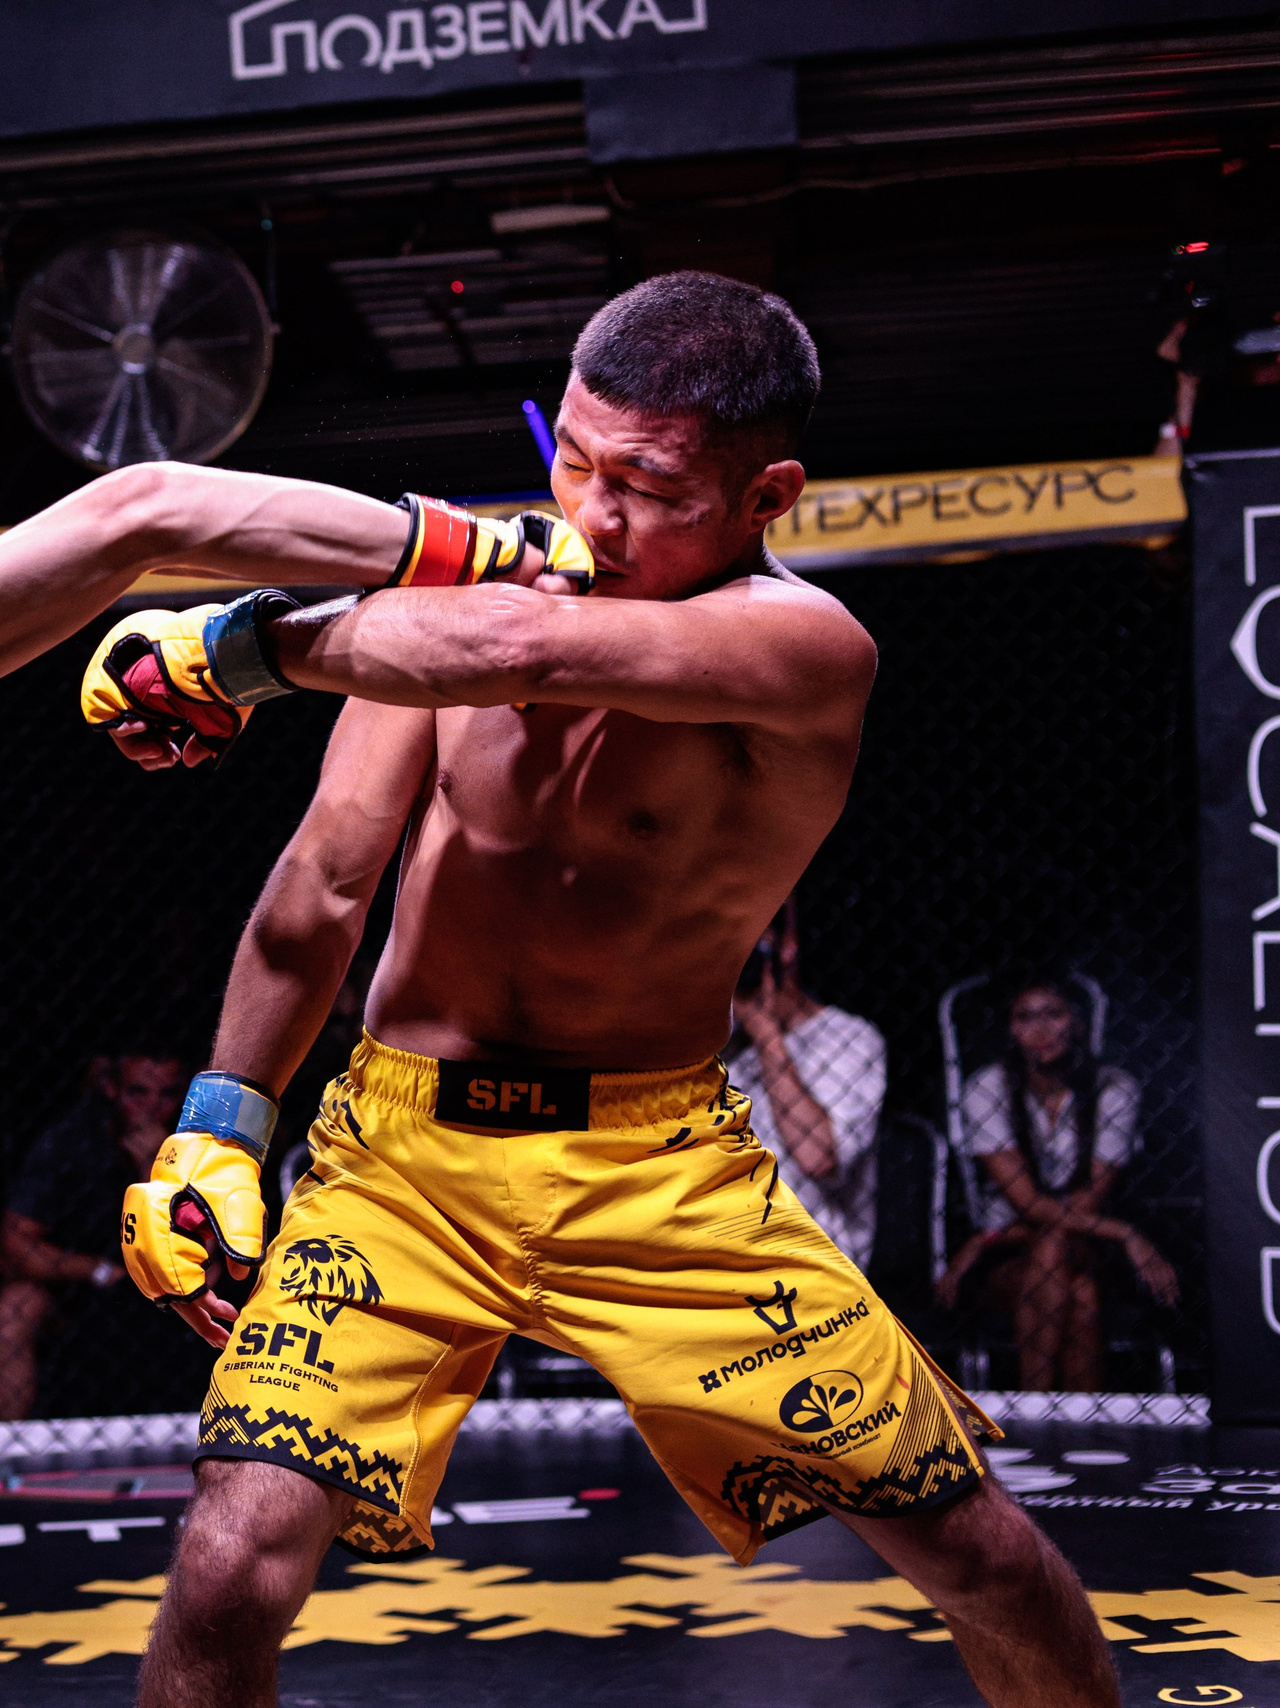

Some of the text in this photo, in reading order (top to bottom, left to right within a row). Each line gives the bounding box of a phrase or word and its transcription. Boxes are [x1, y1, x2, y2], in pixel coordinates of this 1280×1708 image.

[250, 0, 685, 78] ПОДЗЕМКА
[768, 464, 1137, 537] ТЕХРЕСУРС
[466, 1078, 557, 1116] SFL
[236, 1322, 335, 1375] SFL
[223, 1360, 339, 1393] SIBERIAN FIGHTING
[249, 1374, 301, 1392] LEAGUE
